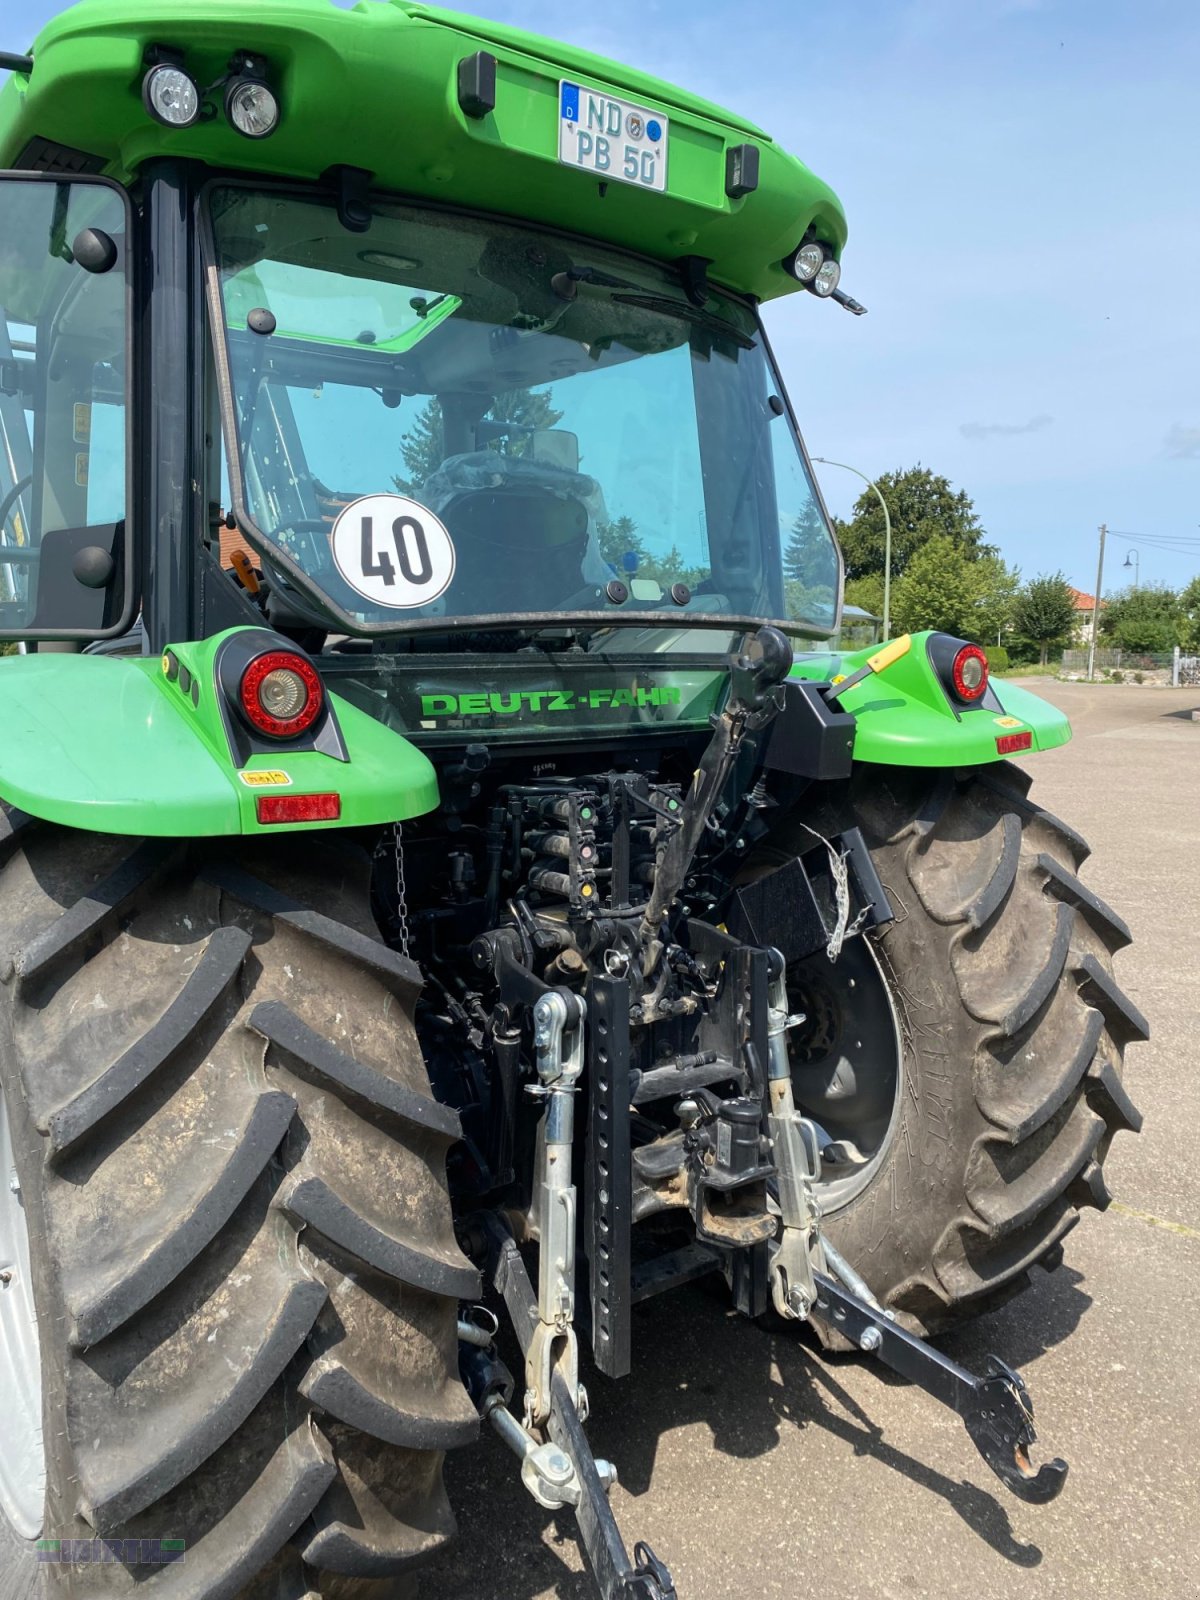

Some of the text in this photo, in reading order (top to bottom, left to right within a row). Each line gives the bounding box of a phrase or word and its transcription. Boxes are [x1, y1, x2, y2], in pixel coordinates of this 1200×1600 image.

[566, 106, 573, 118] D
[587, 95, 622, 137] ND
[577, 129, 655, 185] PB 50
[361, 515, 433, 586] 40
[421, 687, 681, 716] DEUTZ-FAHR
